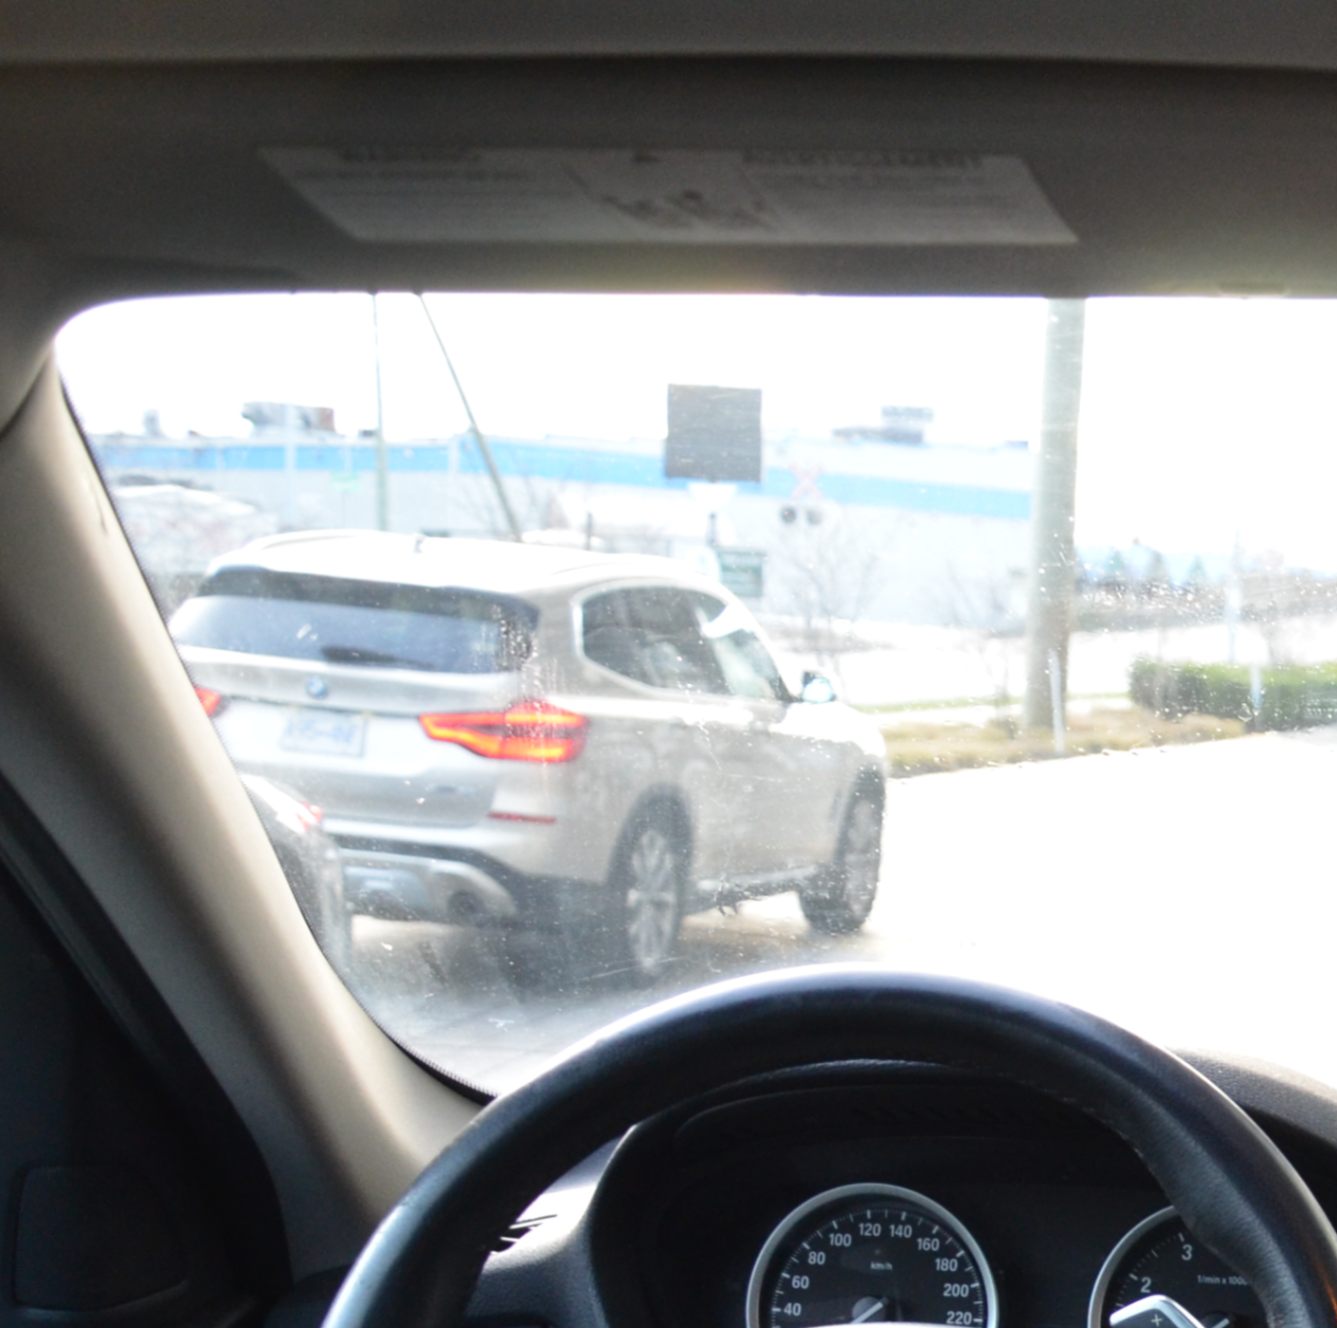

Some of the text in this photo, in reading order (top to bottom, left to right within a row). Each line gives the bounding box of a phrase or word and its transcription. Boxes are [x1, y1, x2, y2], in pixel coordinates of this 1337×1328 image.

[859, 1222, 881, 1237] 120
[890, 1224, 912, 1238] 140
[829, 1233, 852, 1247] 100
[917, 1238, 940, 1251] 160
[808, 1251, 826, 1265] 80
[1181, 1244, 1193, 1260] 3
[870, 1261, 893, 1271] km/h
[935, 1258, 958, 1272] 180
[792, 1275, 810, 1289] 60
[1140, 1276, 1152, 1293] 2
[943, 1283, 969, 1298] 200
[784, 1303, 802, 1316] 40
[946, 1311, 972, 1325] 220
